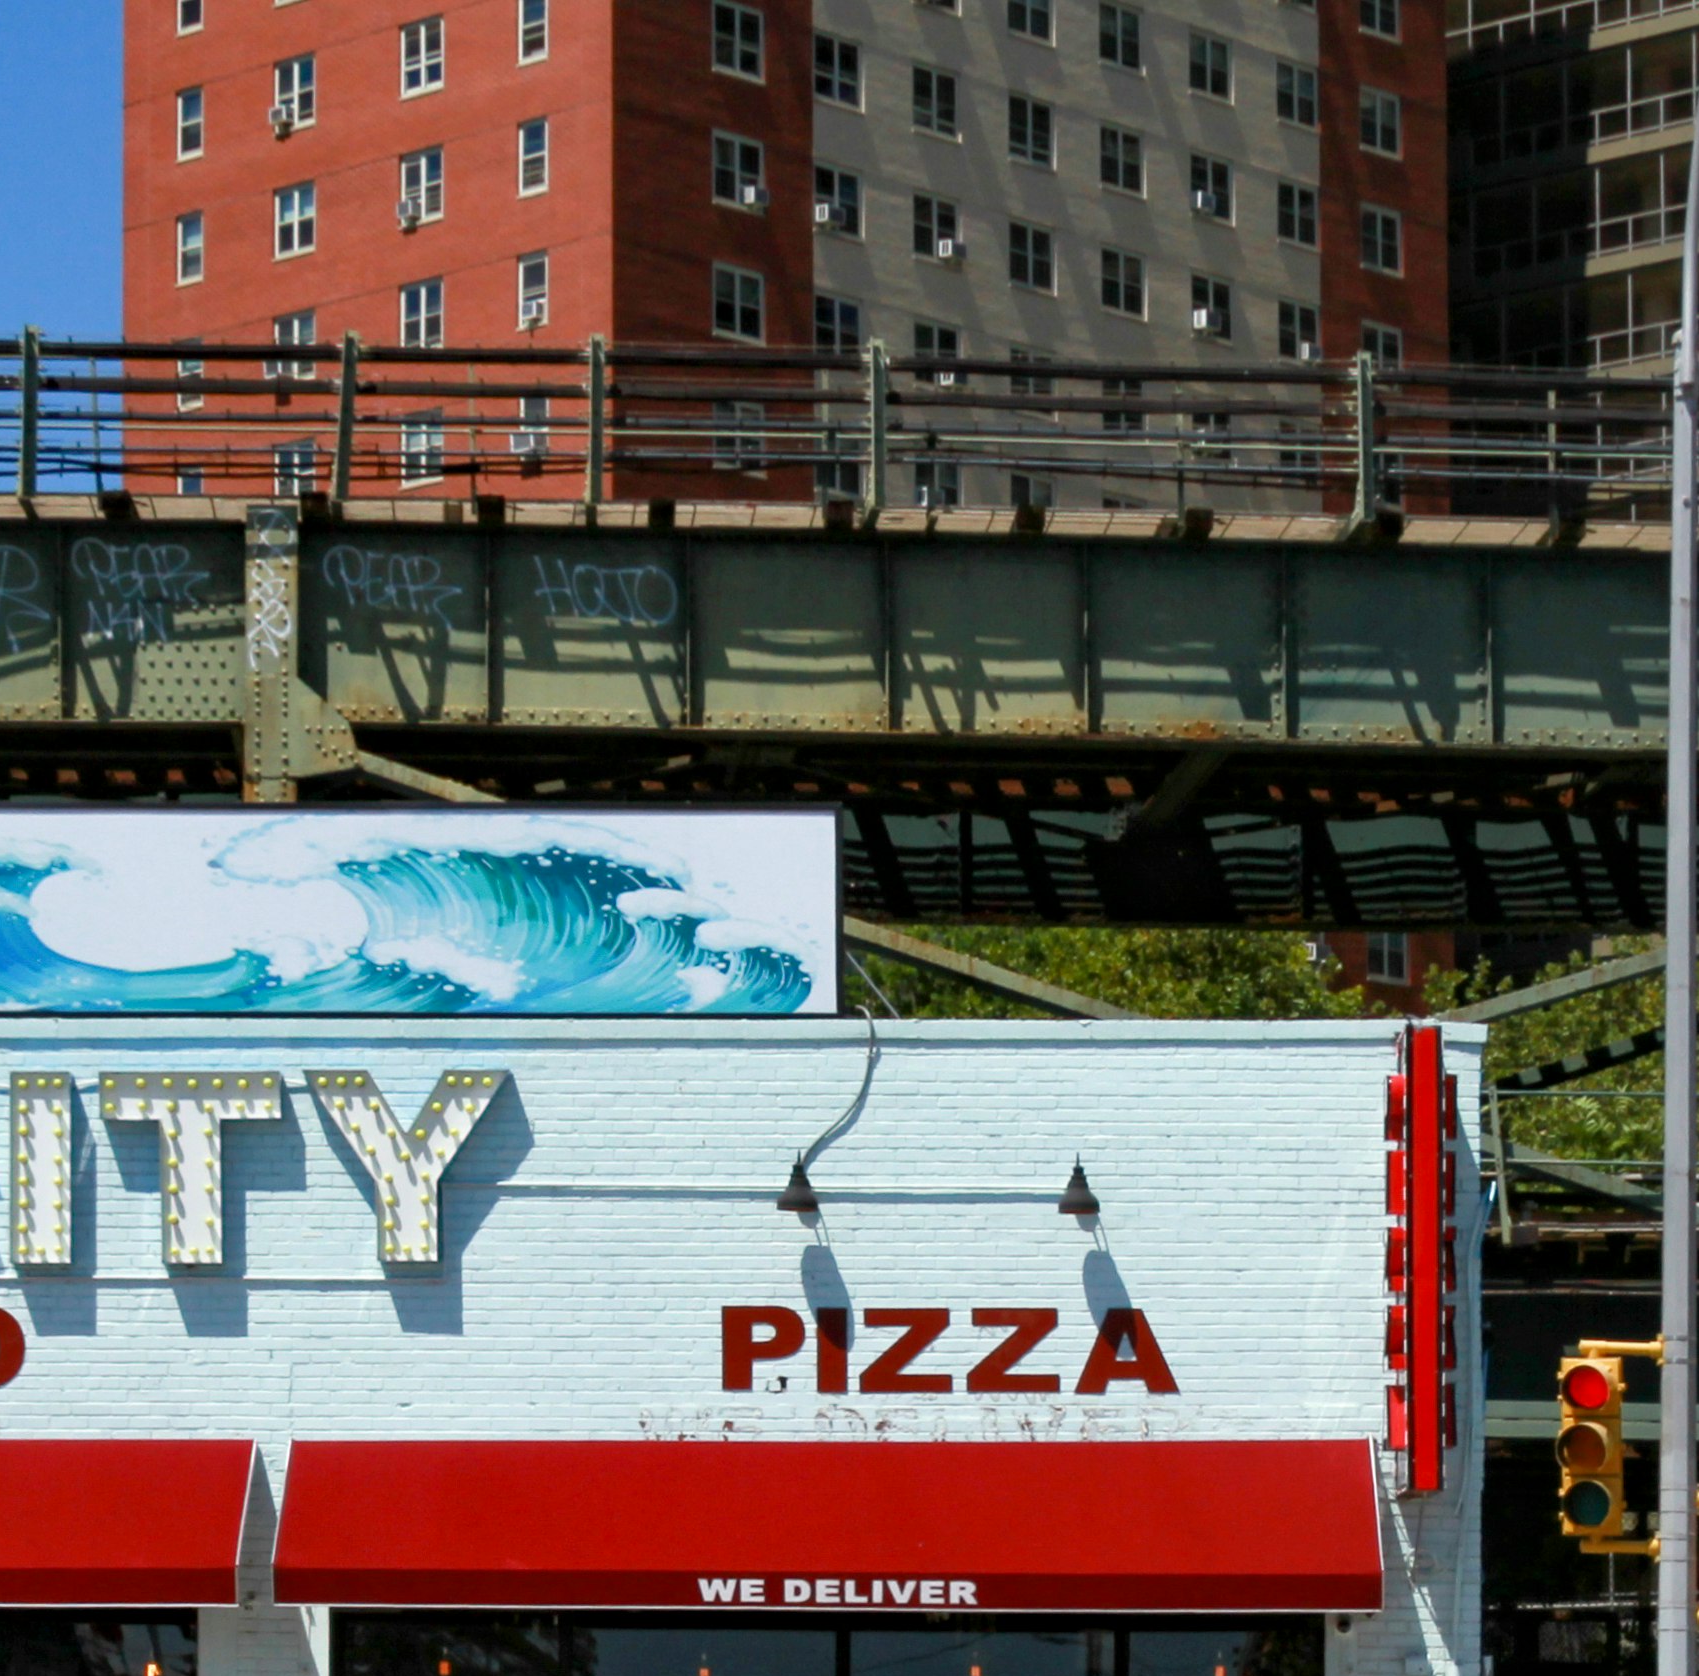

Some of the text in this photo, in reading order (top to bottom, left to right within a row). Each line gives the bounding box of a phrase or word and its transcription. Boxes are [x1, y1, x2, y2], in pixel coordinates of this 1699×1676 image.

[721, 1305, 1180, 1395] PIZZA
[698, 1578, 978, 1605] WE DELIVER
